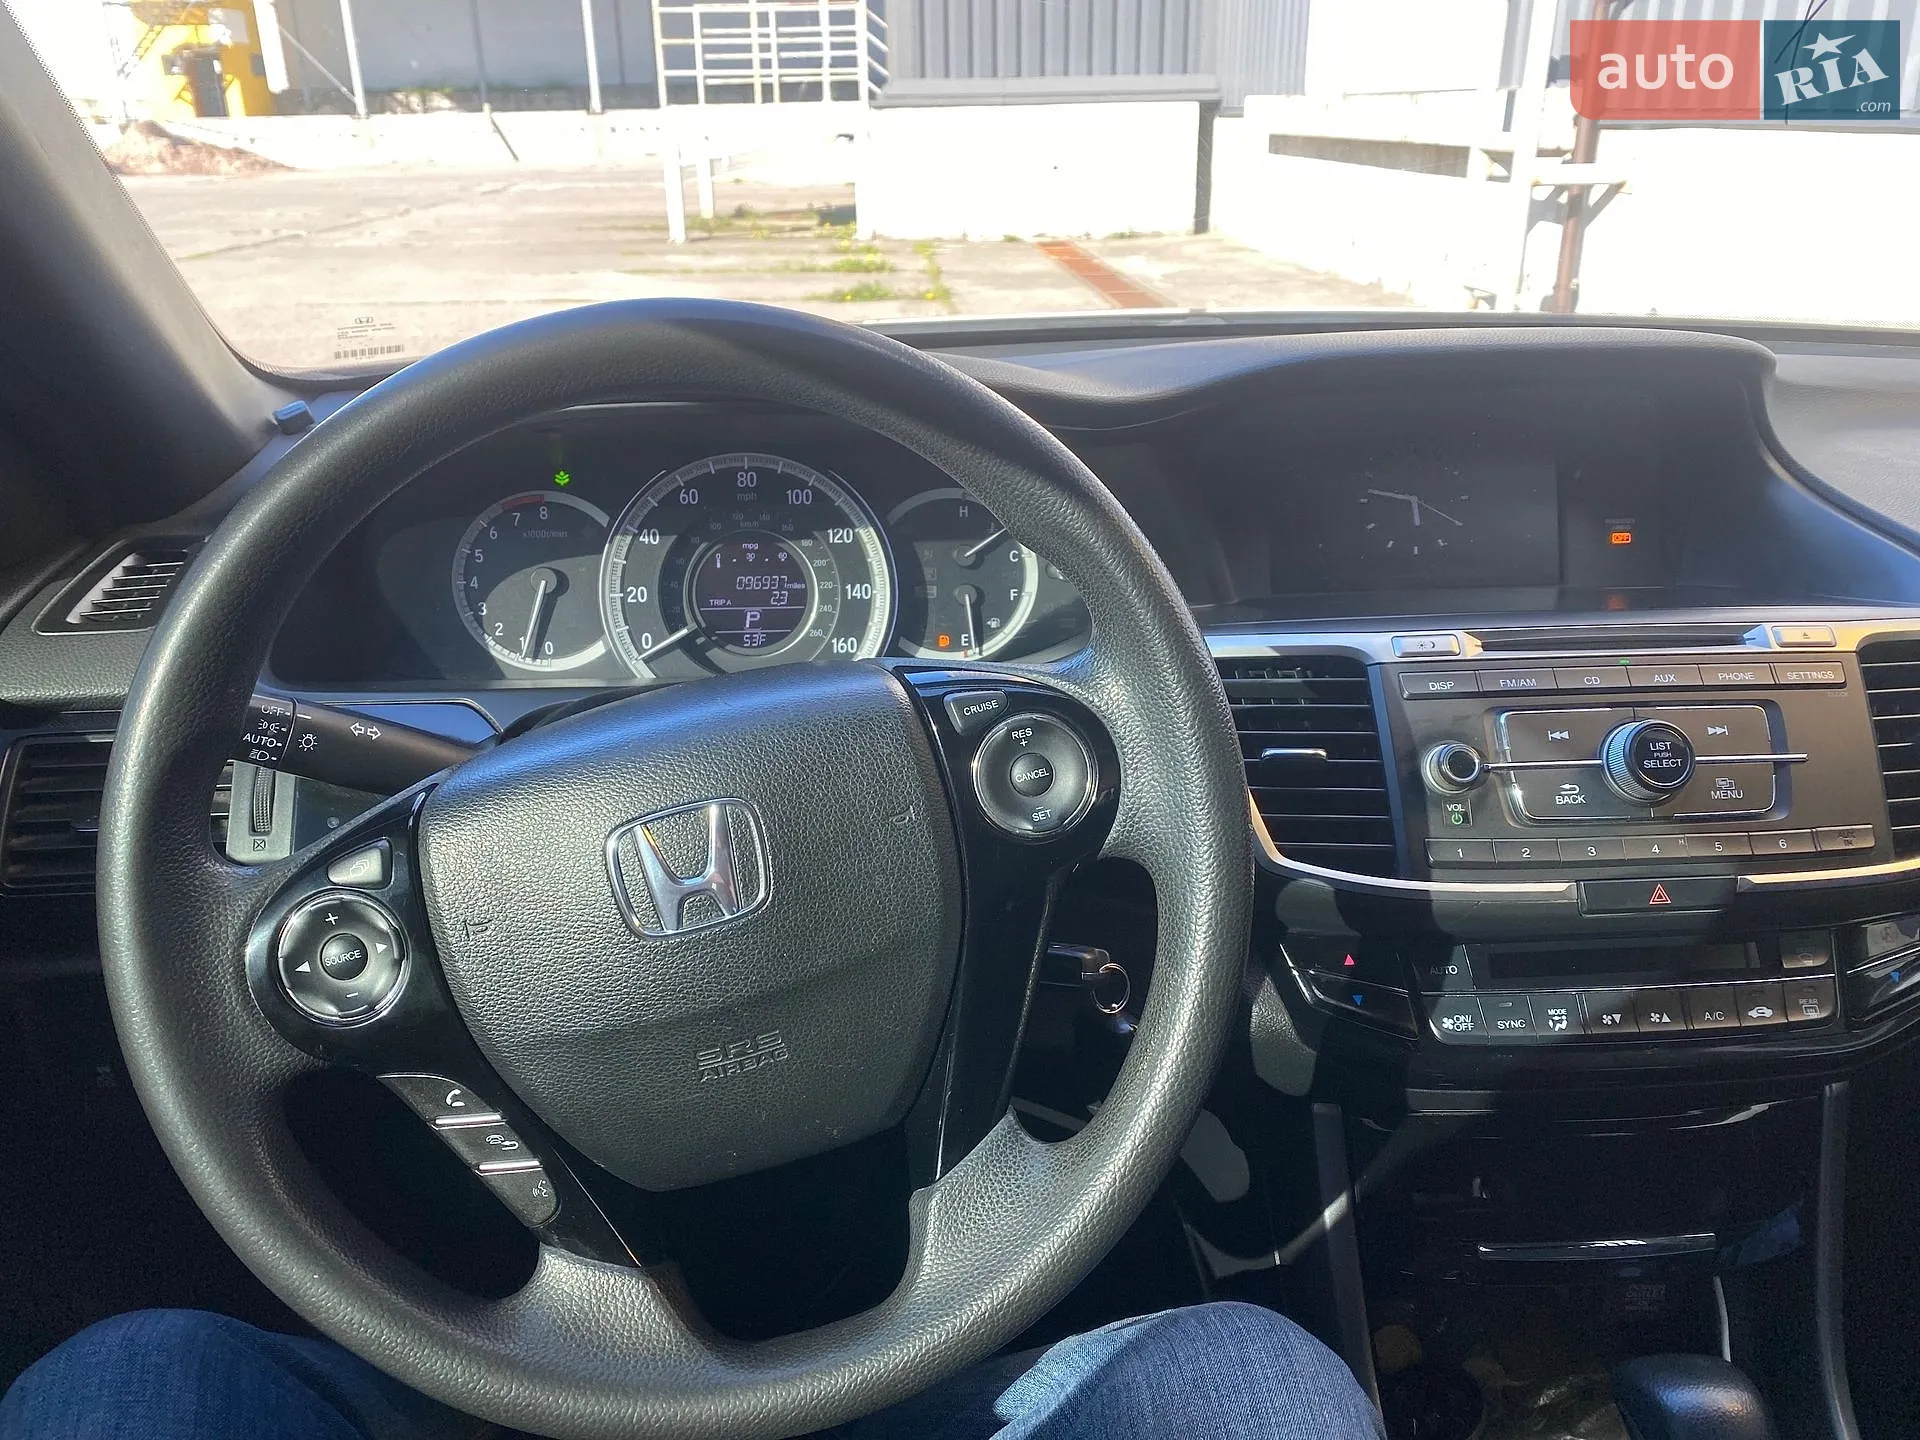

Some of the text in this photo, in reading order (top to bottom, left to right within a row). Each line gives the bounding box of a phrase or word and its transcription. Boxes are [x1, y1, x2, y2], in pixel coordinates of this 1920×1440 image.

[737, 472, 757, 487] 80
[680, 489, 698, 504] 60
[786, 489, 812, 504] 100
[540, 506, 548, 519] 8
[960, 505, 968, 517] H
[512, 512, 520, 526] 7
[490, 526, 497, 540] 6
[639, 529, 660, 545] 40
[827, 528, 853, 544] 120
[475, 549, 483, 563] 5
[1009, 550, 1019, 562] C
[470, 576, 479, 589] 4
[736, 576, 788, 590] 096937
[627, 587, 647, 603] 20
[846, 583, 872, 600] 140
[1010, 589, 1018, 601] F
[478, 602, 487, 616] 3
[745, 612, 760, 628] P
[495, 623, 504, 637] 2
[641, 633, 652, 649] 0
[831, 637, 858, 654] 160
[961, 634, 969, 646] E
[544, 641, 554, 655] 0
[1584, 676, 1600, 686] CD
[1654, 674, 1677, 683] AUX
[1718, 672, 1755, 681] PHONE
[1787, 671, 1834, 680] SETTINGS
[1429, 681, 1455, 691] DISP
[1500, 678, 1537, 688] FM/AM
[261, 705, 284, 717] OFF
[963, 700, 999, 716] CRUISE
[243, 733, 276, 747] AUTO
[1012, 728, 1033, 740] RES
[1650, 742, 1672, 751] LIST
[1643, 759, 1682, 769] SELECT
[1015, 768, 1049, 783] CANCEL
[1555, 795, 1586, 805] BACK
[1711, 790, 1743, 799] MENU
[1447, 804, 1465, 812] VOL
[1032, 808, 1051, 822] SET
[1651, 844, 1660, 855] 4
[1715, 842, 1723, 852] 5
[1779, 839, 1787, 849] 6
[1457, 848, 1463, 858] 1
[1522, 848, 1531, 858] 2
[1587, 847, 1597, 856] 3
[324, 949, 362, 967] SOURCE
[1454, 1015, 1472, 1023] ON/
[1704, 1011, 1725, 1021] A/C
[1454, 1023, 1474, 1031] OFF
[1497, 1019, 1526, 1029] SYNC
[696, 1030, 782, 1066] SRS
[701, 1047, 789, 1082] AIRBAG
